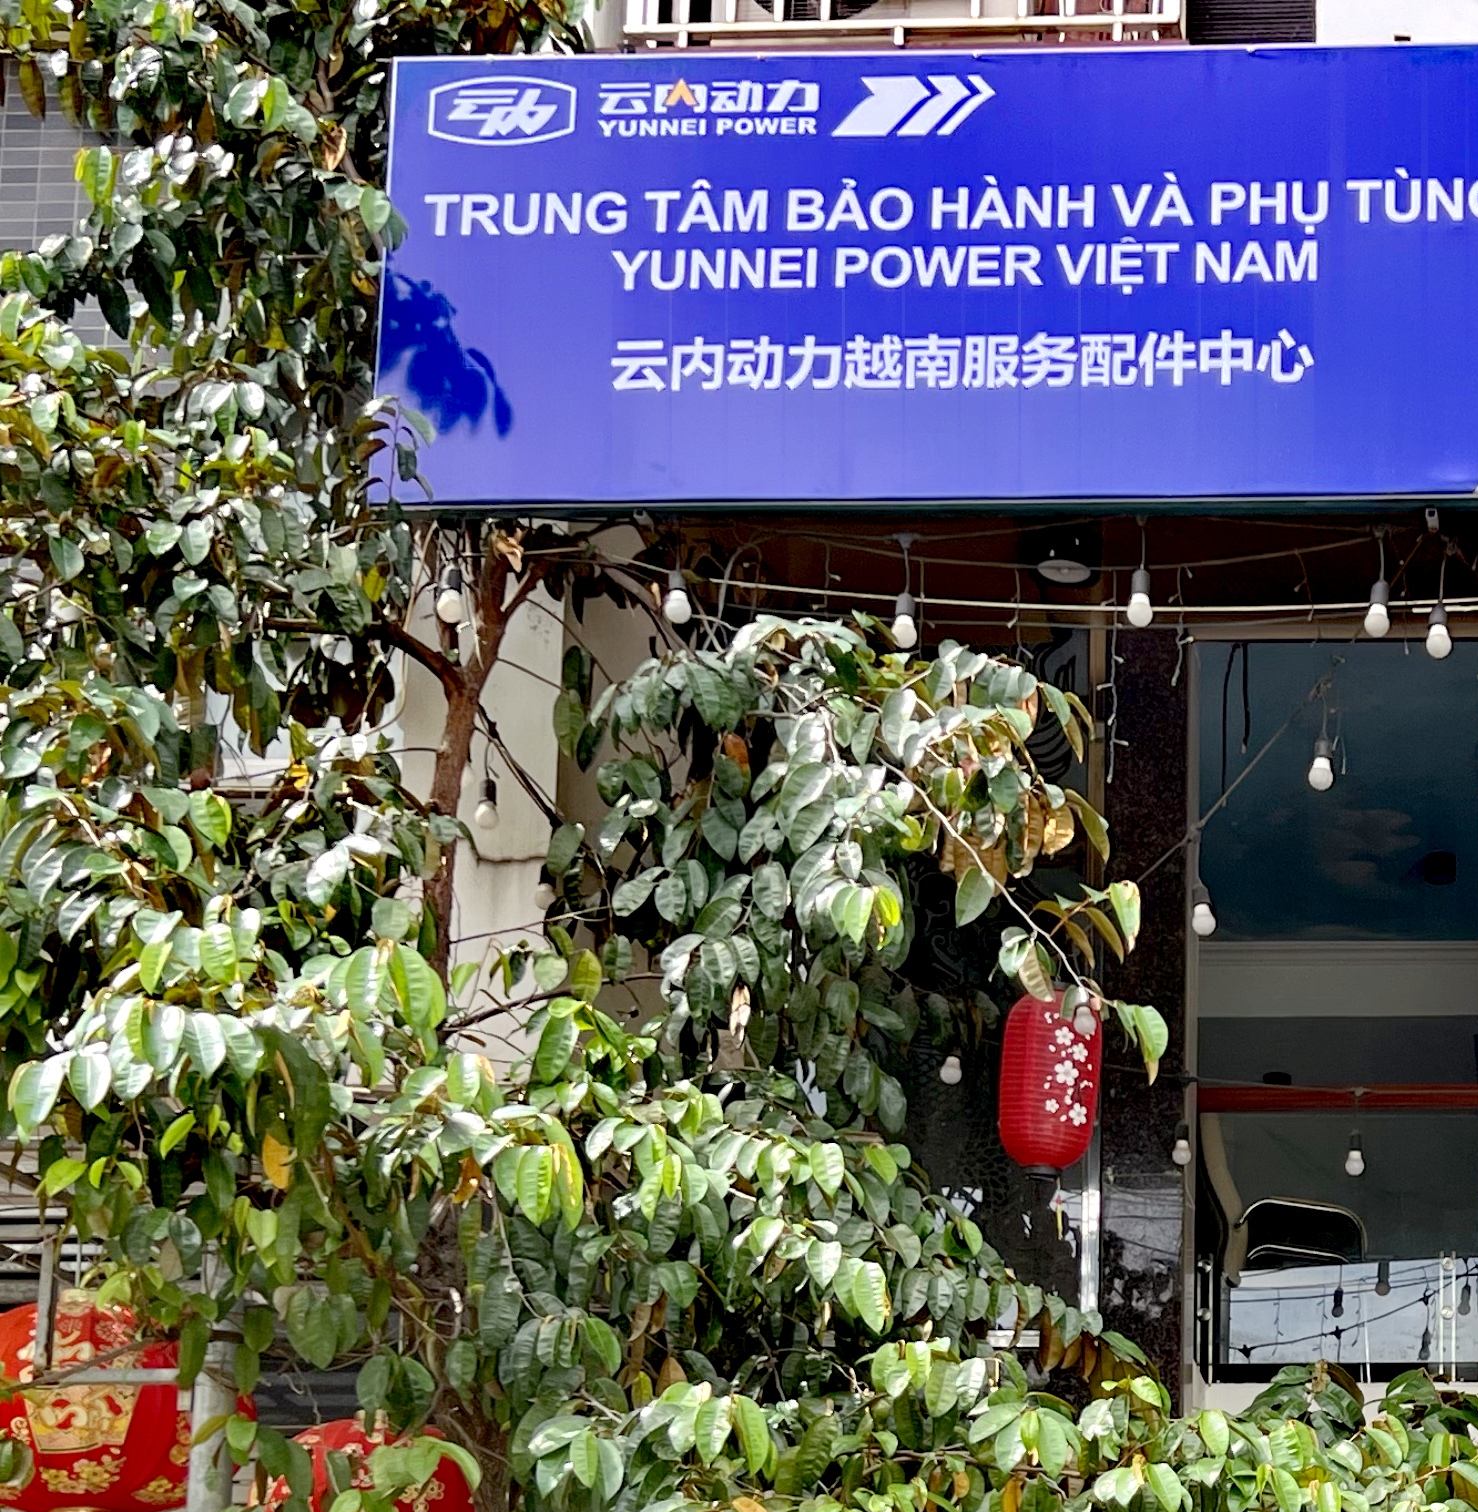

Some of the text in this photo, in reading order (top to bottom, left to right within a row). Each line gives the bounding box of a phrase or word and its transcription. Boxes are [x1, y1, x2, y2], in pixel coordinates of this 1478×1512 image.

[598, 78, 820, 115] 云内动力
[597, 117, 818, 137] YUNNEI POWER
[423, 191, 628, 236] TRUNG
[644, 179, 769, 233] TÂM
[786, 179, 914, 231] BẢO
[931, 175, 1095, 230] HÀNH
[1111, 171, 1194, 227] VÀ
[1210, 180, 1329, 235] PHỤ
[611, 236, 1319, 295] YUNNEI POWER VIỆT NAM
[611, 328, 1315, 391] 云内动力越南服务配件中心
